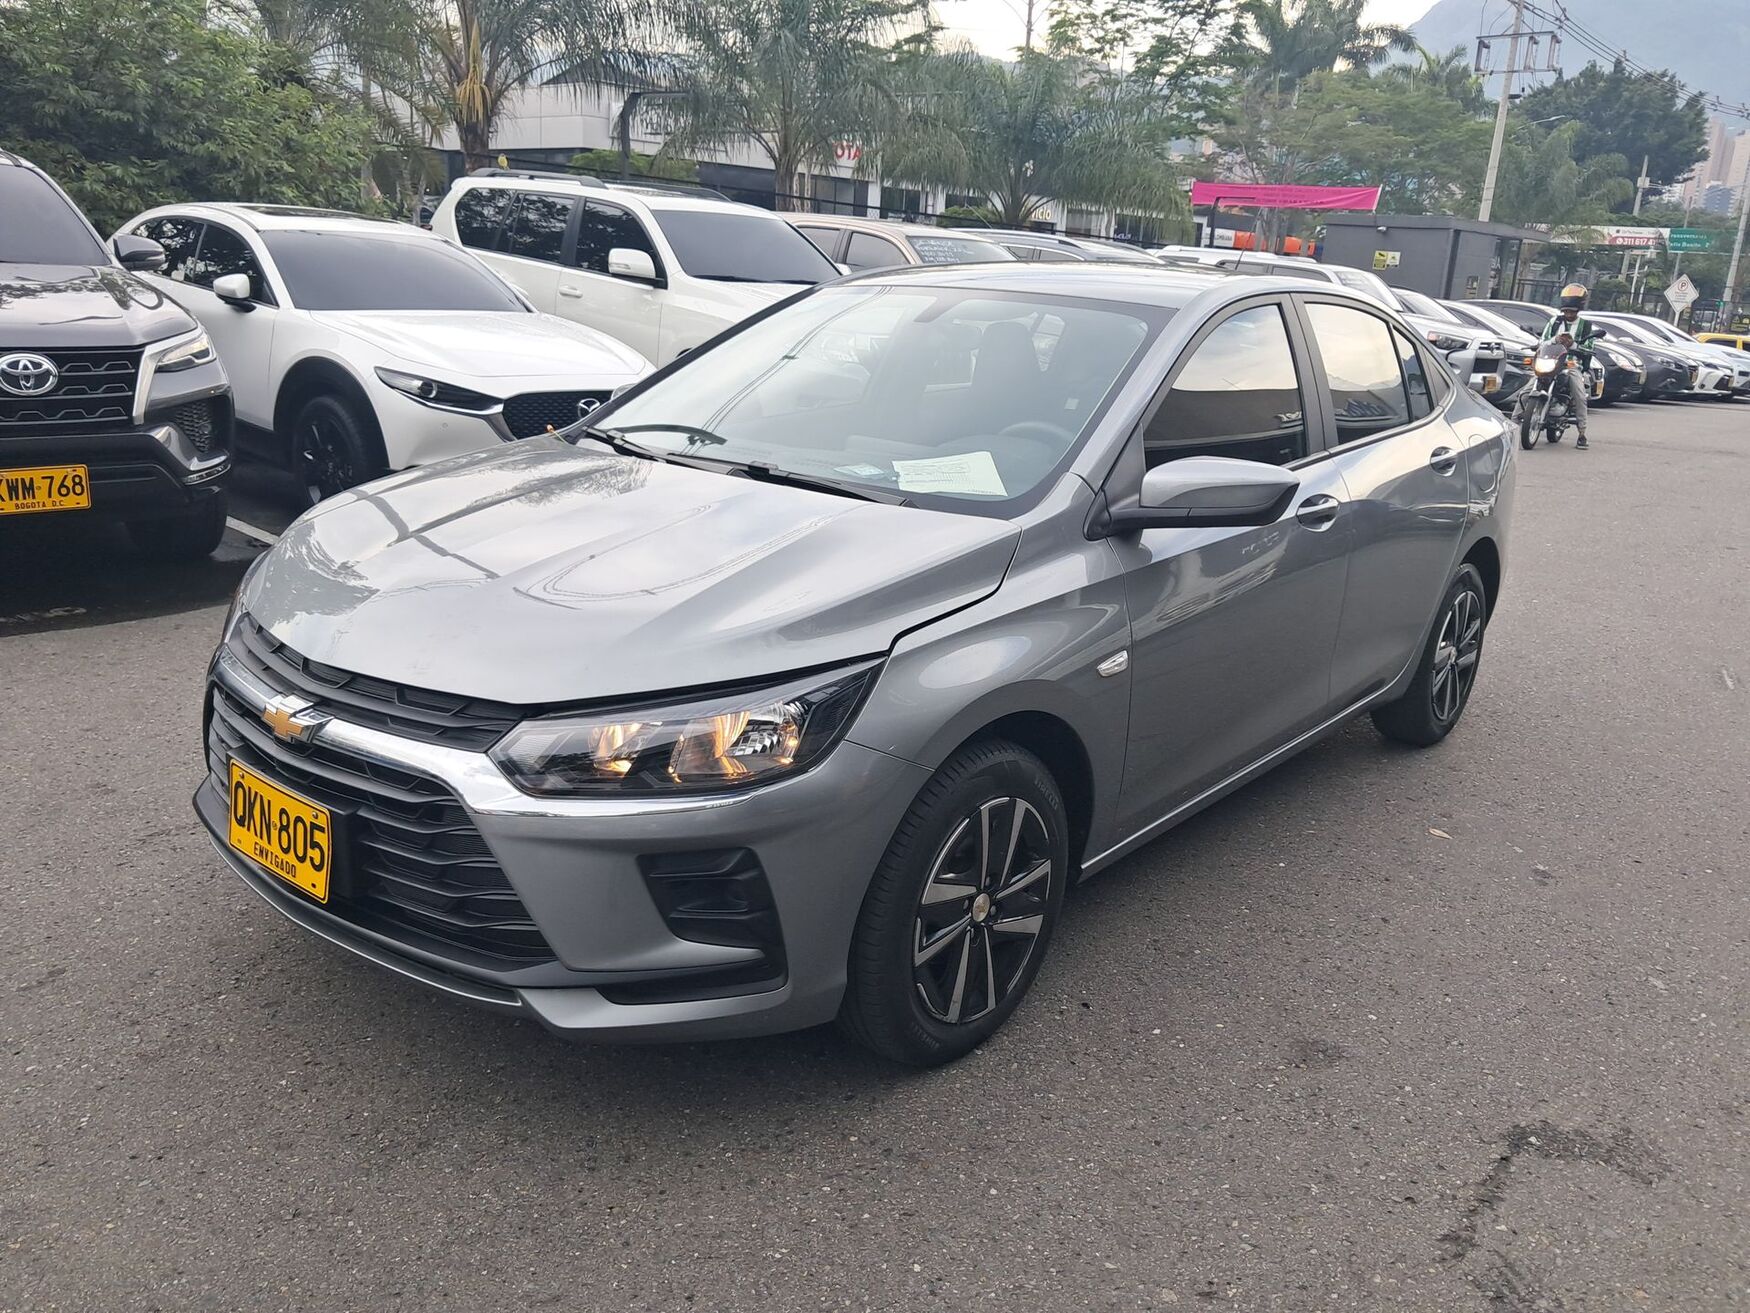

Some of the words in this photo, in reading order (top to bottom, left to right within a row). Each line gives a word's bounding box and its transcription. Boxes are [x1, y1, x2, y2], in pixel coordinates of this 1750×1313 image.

[41, 474, 85, 499] 768
[277, 807, 326, 873] 805
[253, 842, 297, 879] ENVIGADO
